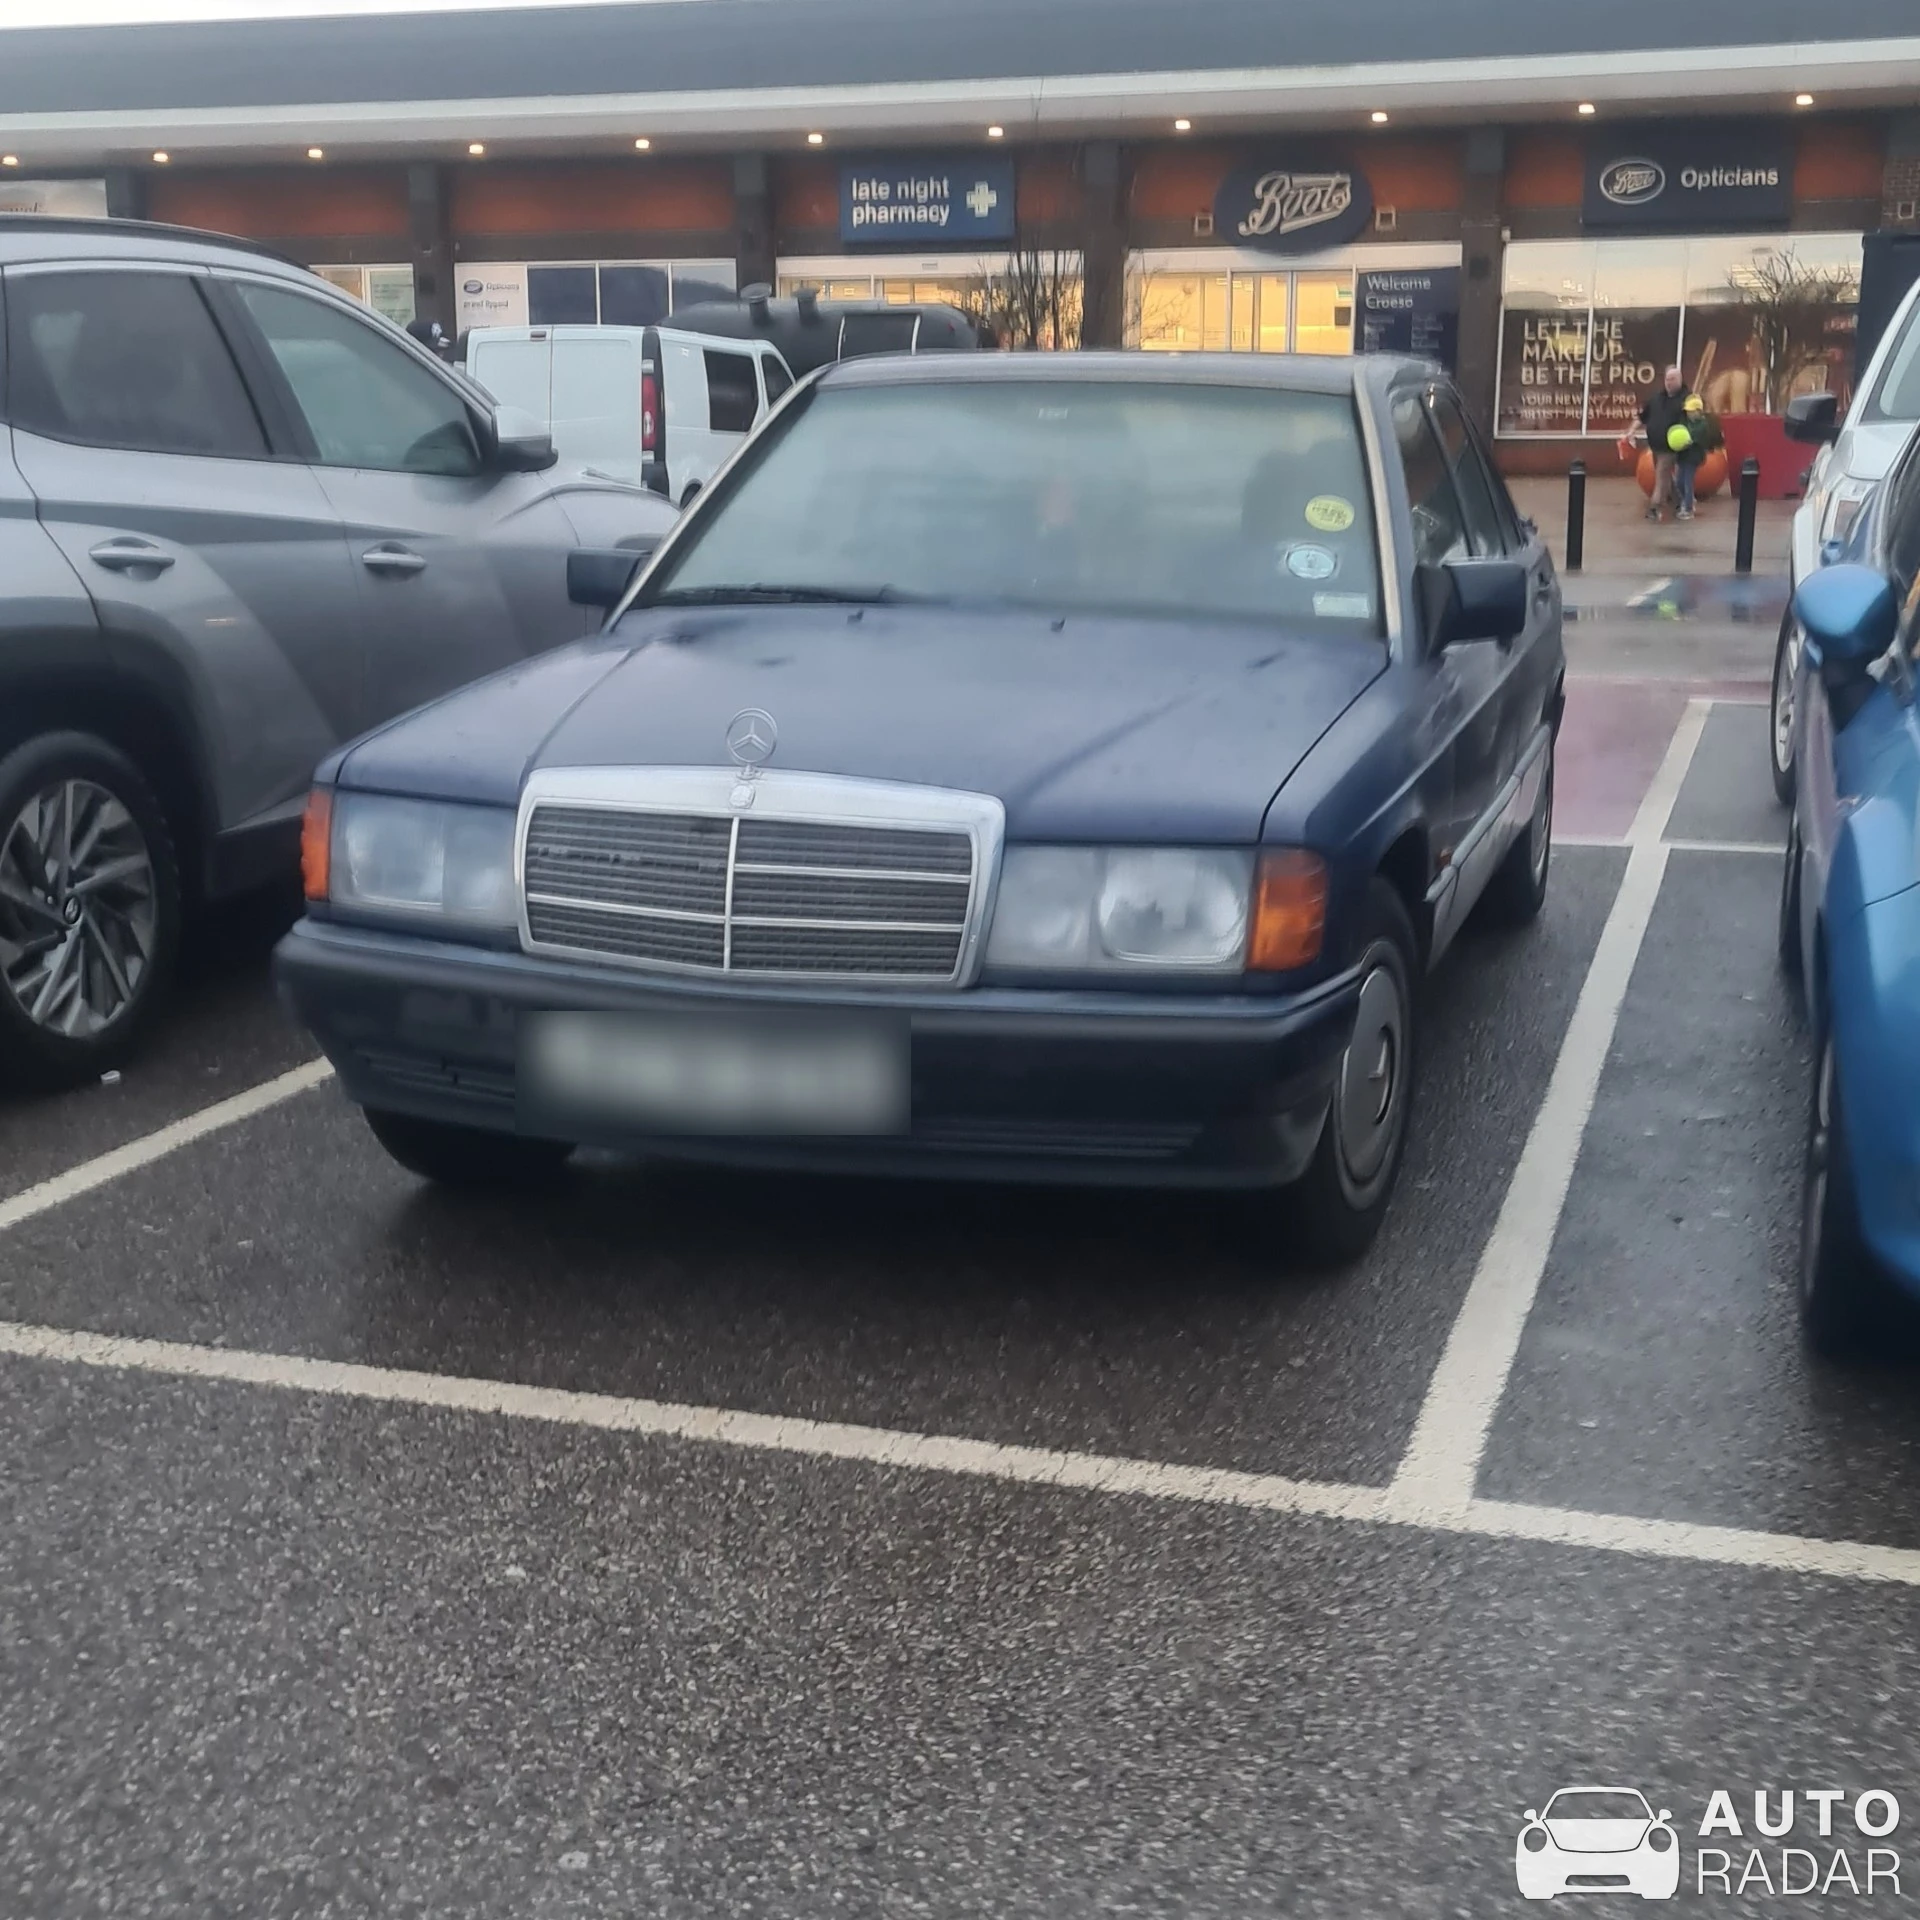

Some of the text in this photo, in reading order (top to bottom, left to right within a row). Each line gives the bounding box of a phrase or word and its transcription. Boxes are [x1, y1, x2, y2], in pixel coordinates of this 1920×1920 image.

[852, 176, 950, 203] late night
[1680, 164, 1779, 191] Opticians
[852, 202, 950, 228] pharmacy
[1238, 171, 1351, 236] Boots
[1366, 274, 1432, 291] Welcome
[1524, 317, 1624, 340] LET THE
[1520, 363, 1656, 385] BE THE PRO
[1521, 391, 1552, 406] YOUR
[1554, 391, 1583, 406] NEW
[1612, 391, 1637, 406] PRO
